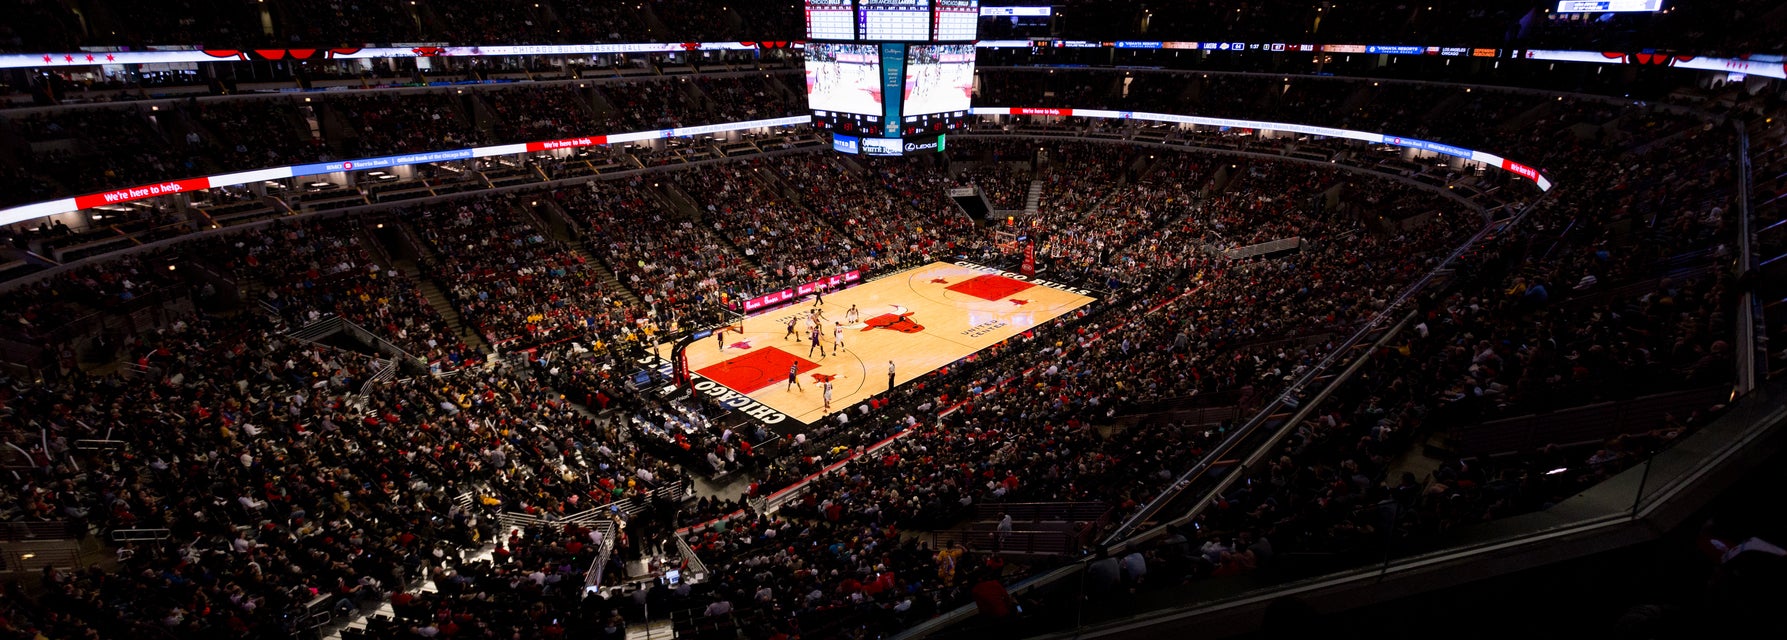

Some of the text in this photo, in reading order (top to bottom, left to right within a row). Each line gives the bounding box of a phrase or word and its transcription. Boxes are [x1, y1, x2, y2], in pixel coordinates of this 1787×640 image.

[104, 191, 128, 202] We're
[129, 189, 149, 198] here
[160, 182, 182, 193] help.
[1032, 278, 1091, 296] BULLS
[960, 320, 997, 335] UNITED
[970, 323, 1007, 337] CENTER
[694, 381, 786, 424] CHICAGO
